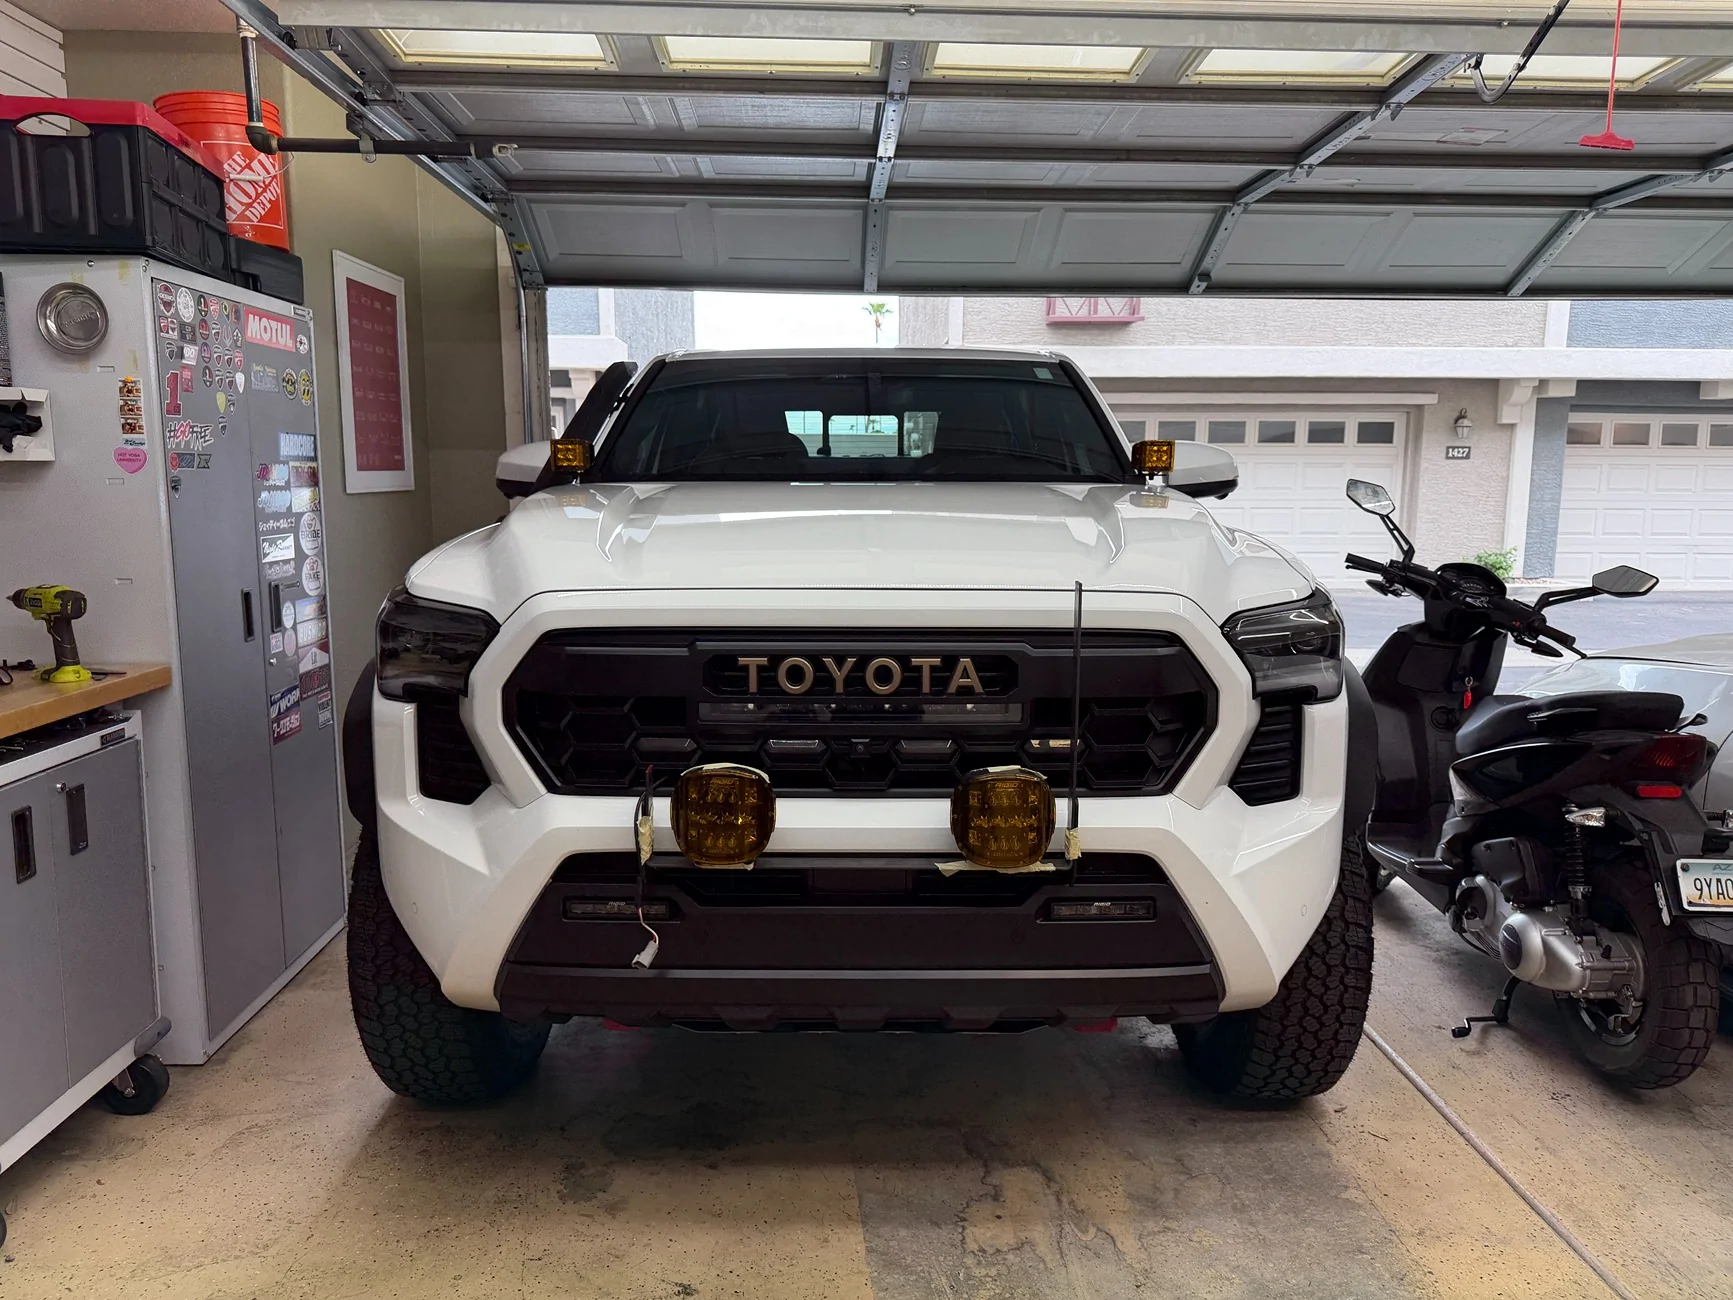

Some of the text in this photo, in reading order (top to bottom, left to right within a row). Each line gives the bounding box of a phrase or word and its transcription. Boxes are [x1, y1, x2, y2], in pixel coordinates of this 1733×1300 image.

[244, 179, 281, 222] DEPOT
[247, 313, 293, 350] MOTUL
[280, 432, 316, 457] HARDCORE
[1448, 448, 1469, 457] 1427
[300, 529, 321, 540] BRIDE
[304, 571, 320, 582] FAKE
[736, 656, 987, 695] TOYOTA
